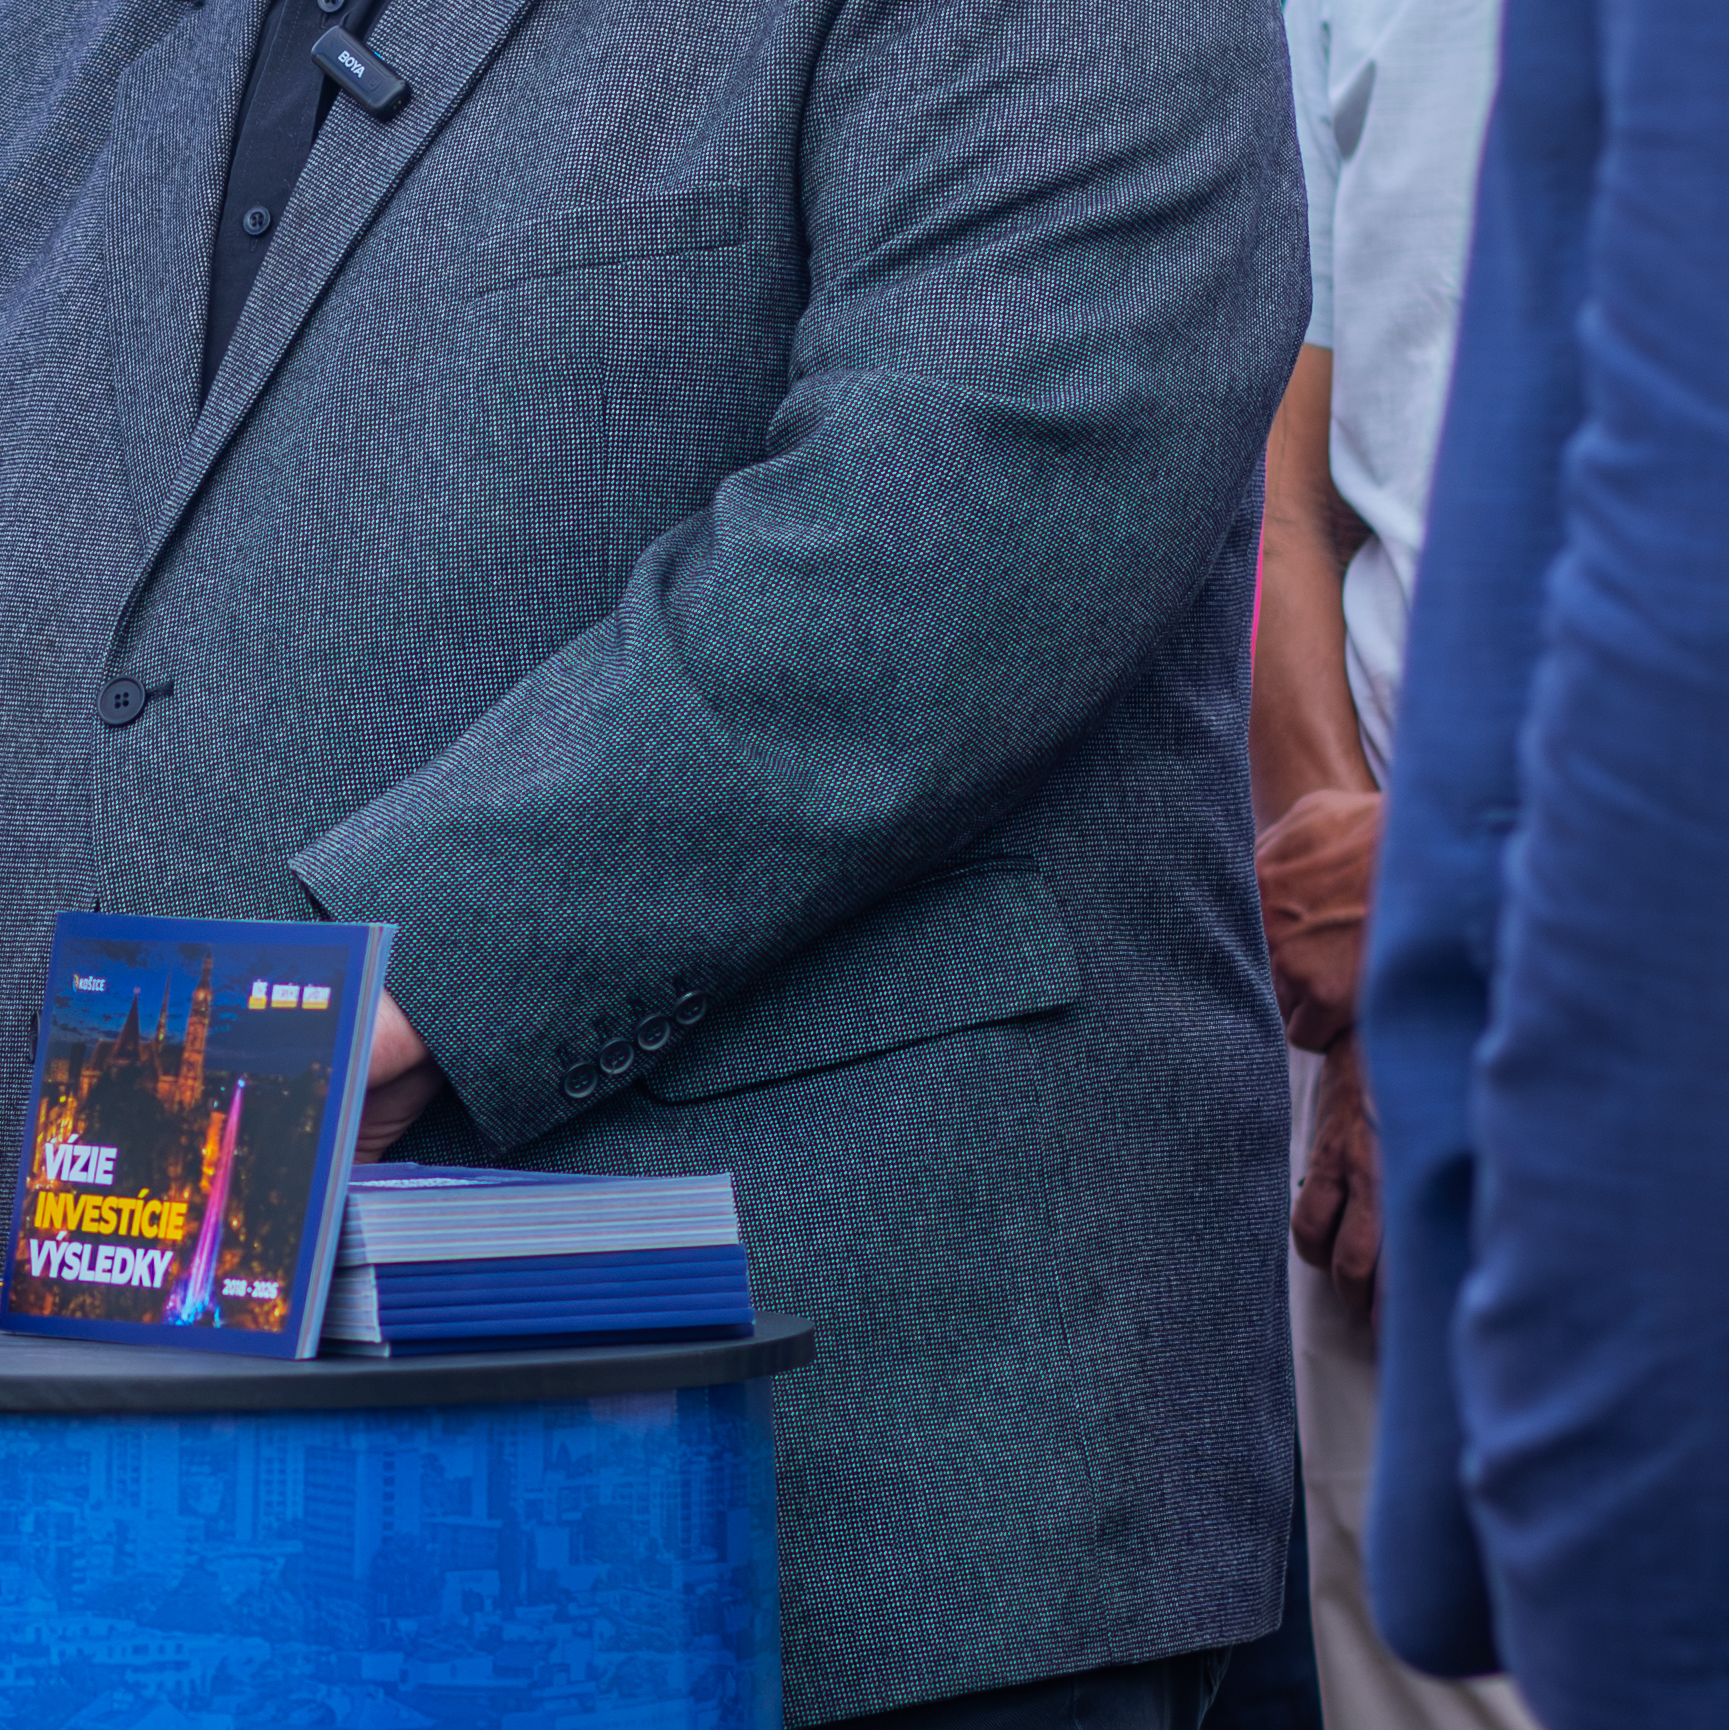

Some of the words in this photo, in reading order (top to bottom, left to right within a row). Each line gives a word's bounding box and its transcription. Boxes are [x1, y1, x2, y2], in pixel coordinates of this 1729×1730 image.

[337, 50, 366, 79] BOYA
[44, 1133, 118, 1186] VÍZIE
[34, 1188, 188, 1241] INVESTÍCIE
[28, 1230, 174, 1289] VÝSLEDKY
